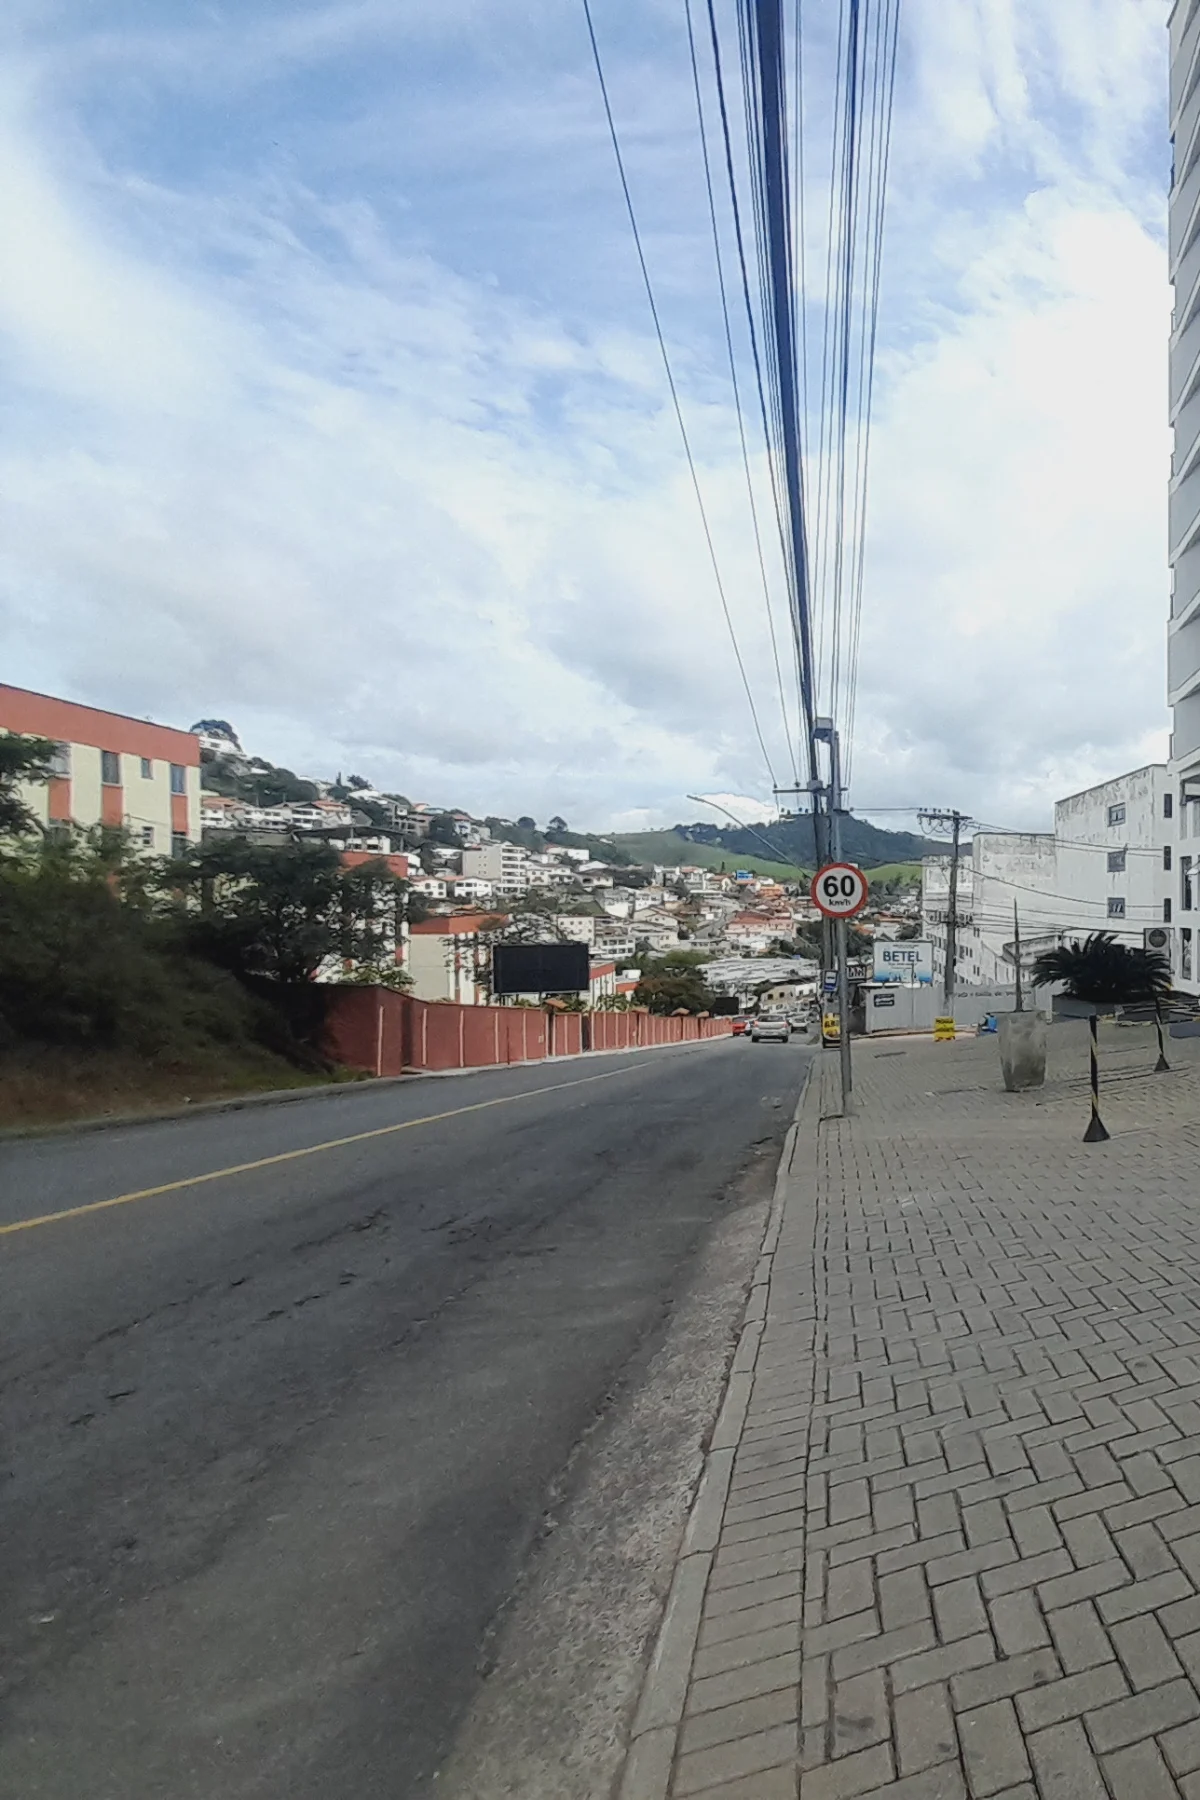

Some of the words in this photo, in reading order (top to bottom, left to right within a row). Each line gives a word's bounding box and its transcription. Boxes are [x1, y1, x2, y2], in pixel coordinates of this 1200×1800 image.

[823, 875, 855, 897] 60
[829, 898, 851, 906] km/h
[883, 951, 923, 962] BETEL
